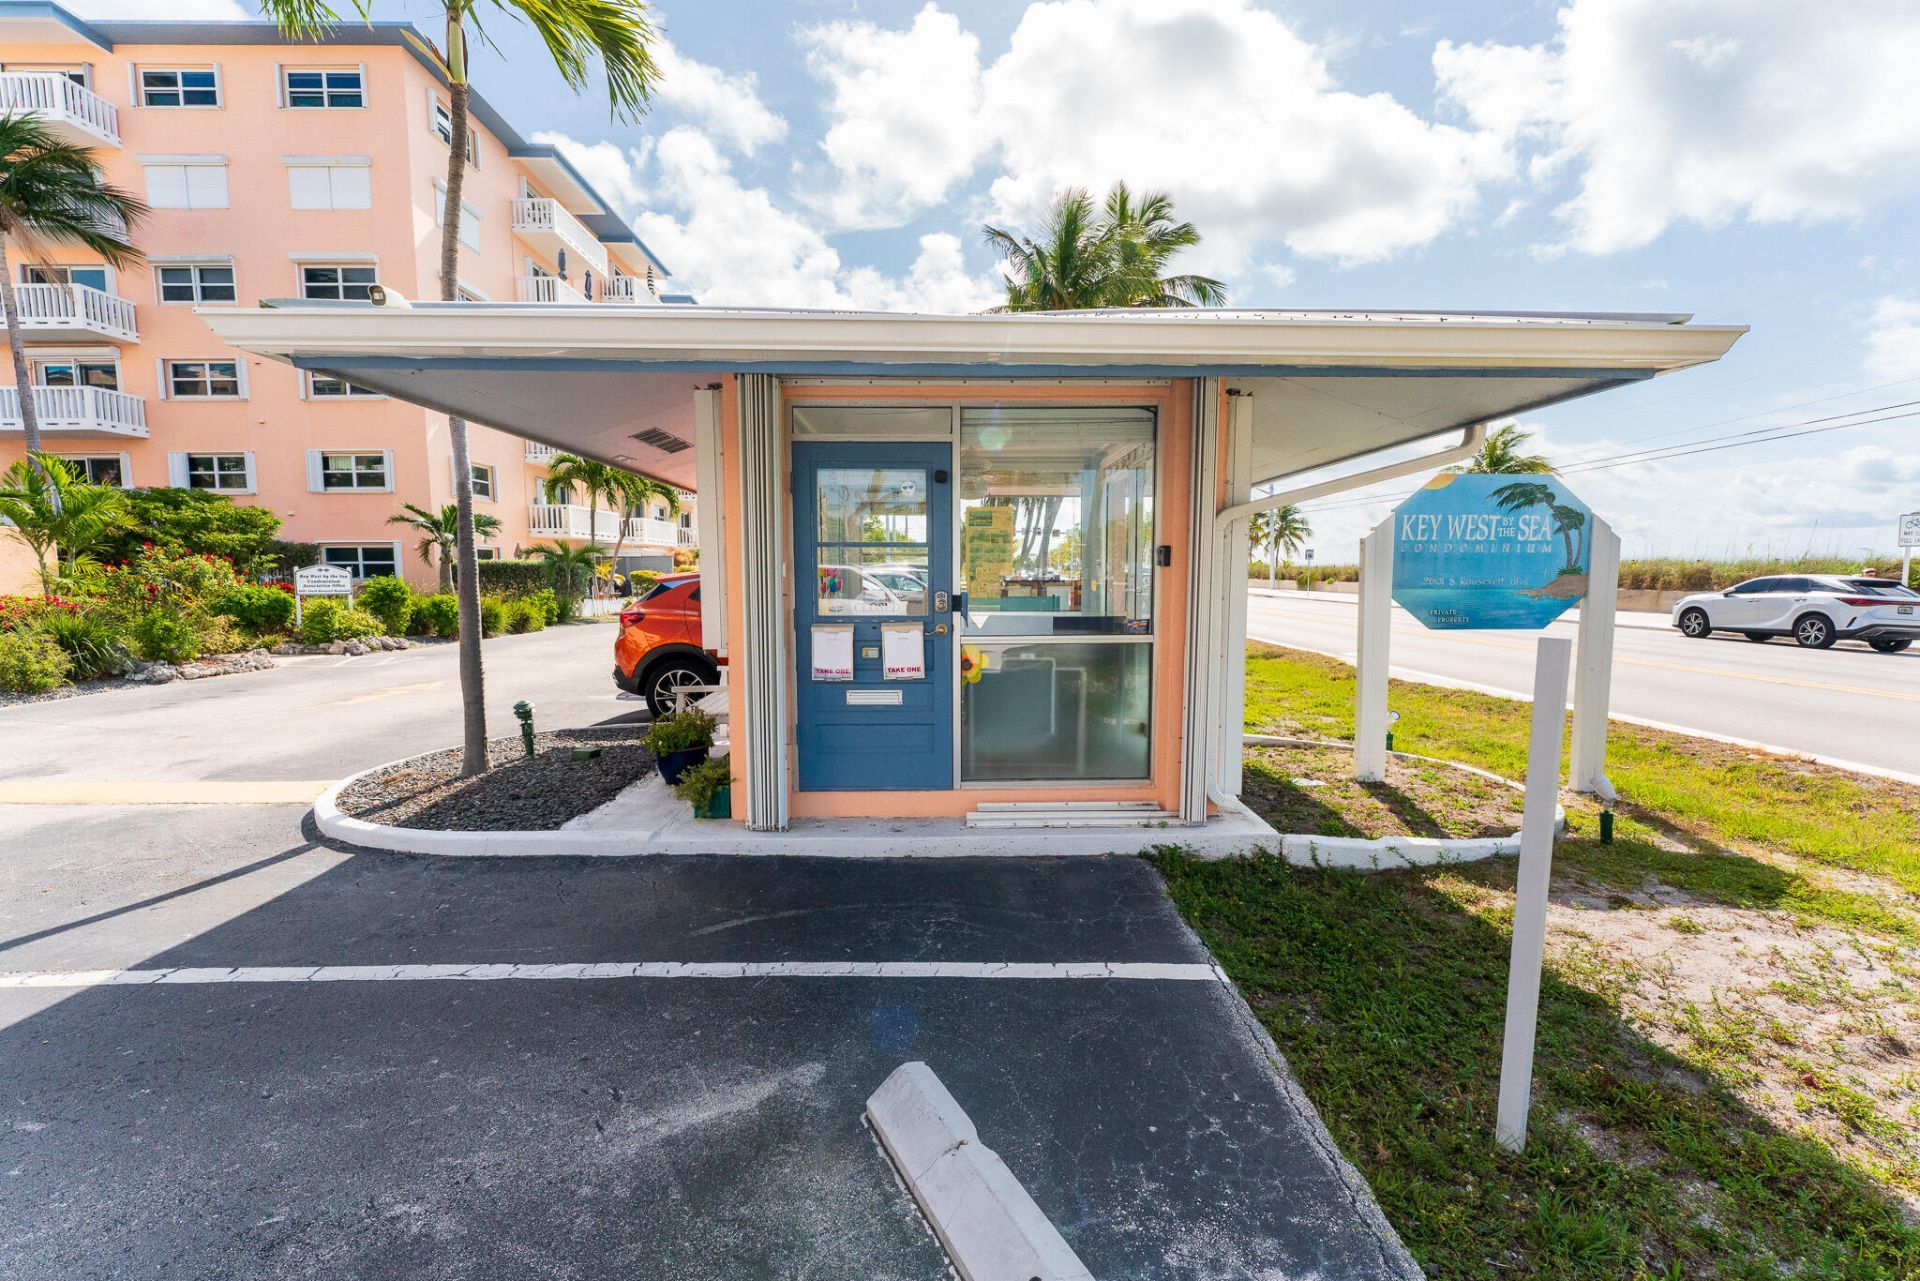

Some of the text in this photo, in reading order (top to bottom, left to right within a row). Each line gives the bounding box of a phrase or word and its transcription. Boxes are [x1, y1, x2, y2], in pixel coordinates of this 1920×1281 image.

[1401, 514, 1552, 541] KEY WEST BY THE SEA
[1400, 543, 1552, 553] CONDOMINIUM
